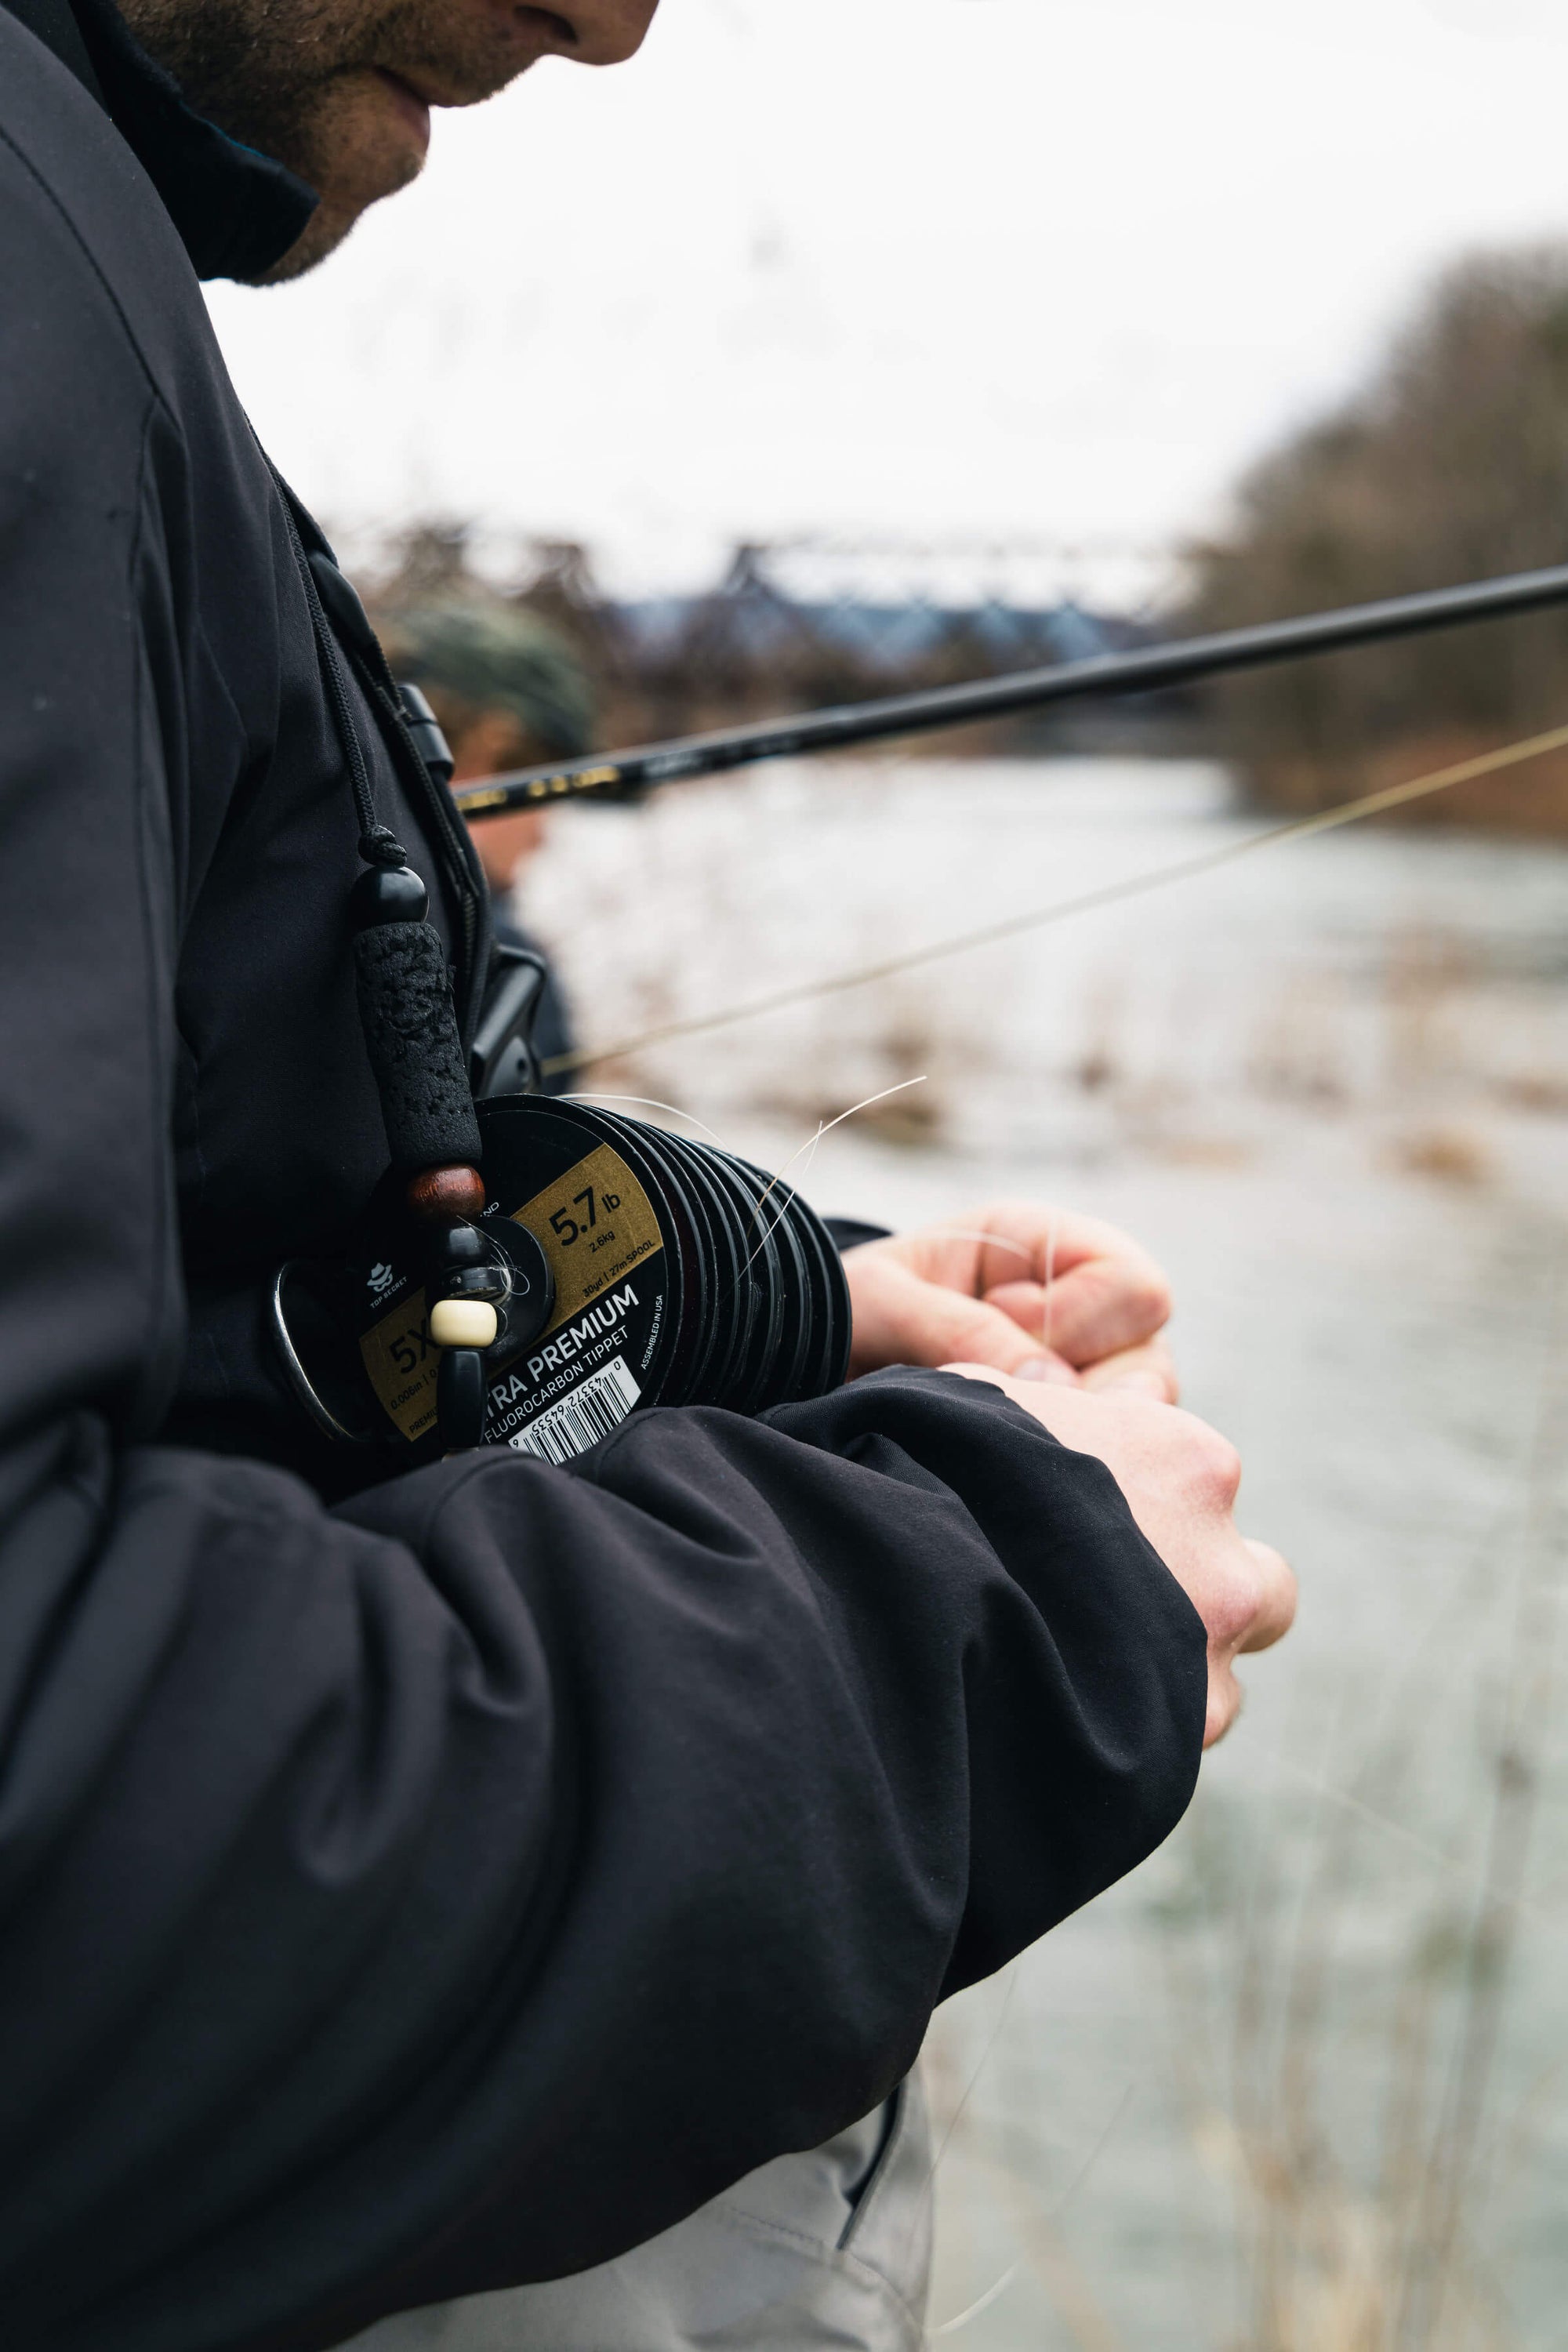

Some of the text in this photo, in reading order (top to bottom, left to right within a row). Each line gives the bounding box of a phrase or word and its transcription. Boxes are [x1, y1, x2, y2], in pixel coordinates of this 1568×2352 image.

[548, 1185, 621, 1247] 5.7 lb
[590, 1231, 615, 1253] 2.6kg
[370, 1276, 407, 1308] TOP SECRET
[583, 1278, 604, 1298] 30yd
[609, 1261, 628, 1276] 27m
[626, 1240, 655, 1263] SPOOL
[389, 1318, 440, 1374] 5X
[527, 1283, 640, 1382] PREMIUM
[641, 1294, 663, 1370] ASSEMBLED IN USA
[484, 1325, 628, 1444] FLUOROCARBON TIPPET
[569, 1377, 603, 1407] 43372
[408, 1406, 439, 1434] PREMIU
[532, 1404, 564, 1436] 64535
